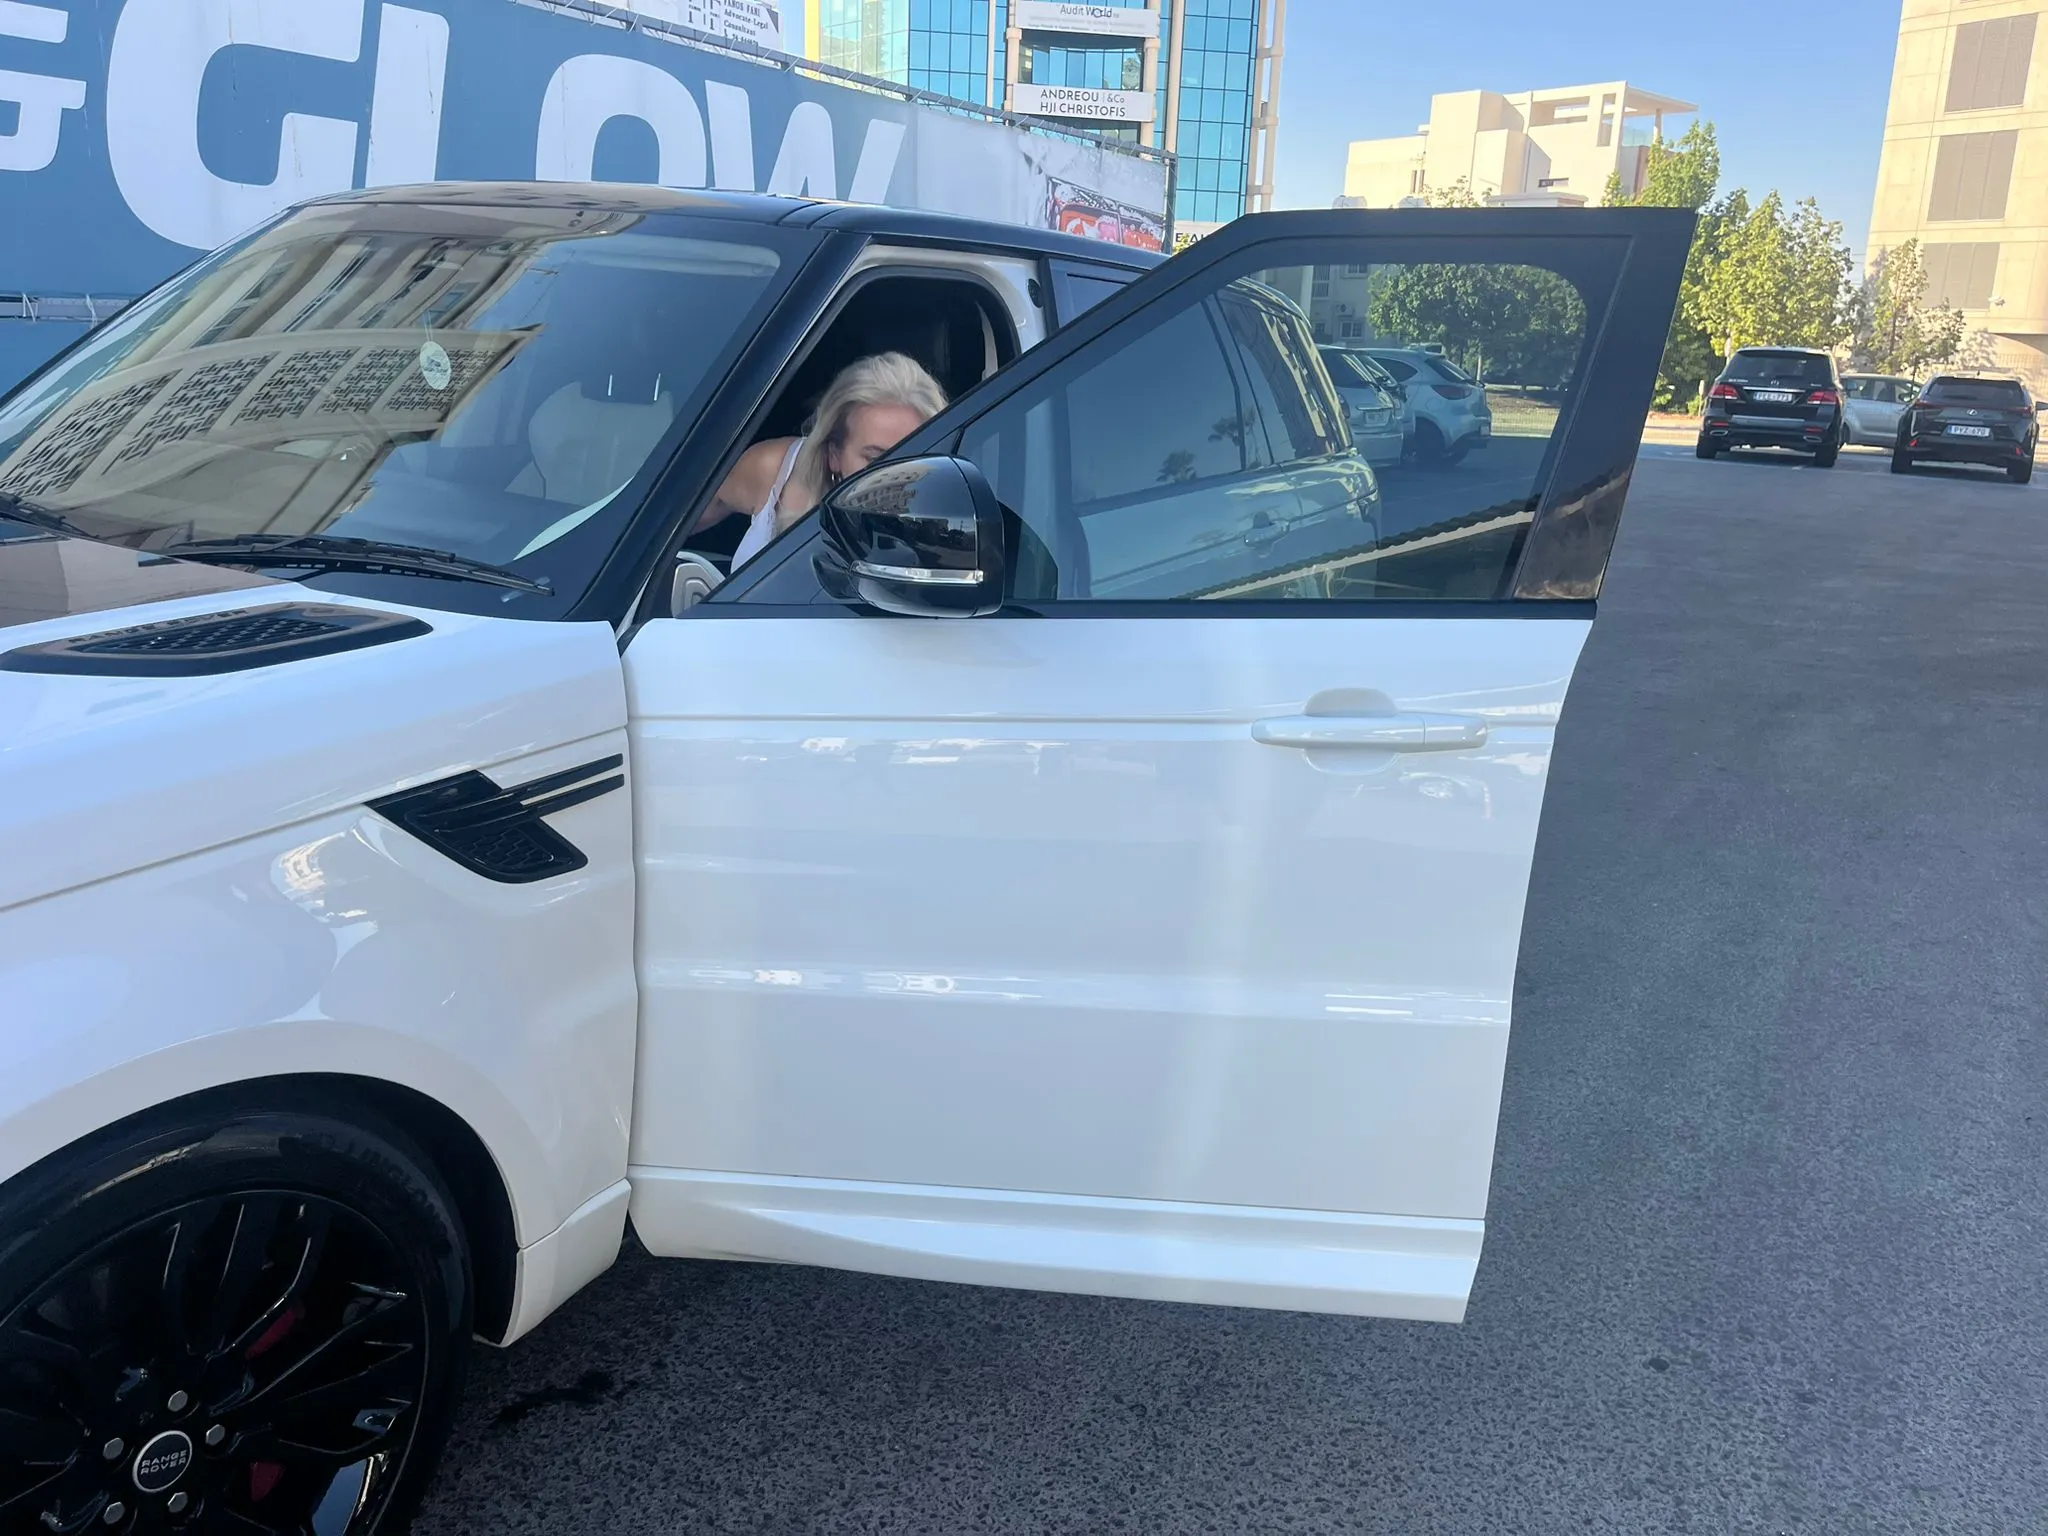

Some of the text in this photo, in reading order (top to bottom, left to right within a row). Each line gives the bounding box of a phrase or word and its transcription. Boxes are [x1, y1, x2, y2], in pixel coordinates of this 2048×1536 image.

[1060, 5, 1084, 16] Audit
[1041, 89, 1099, 102] ANDREOU
[1040, 102, 1126, 117] HJI CHRISTOFIS
[141, 1457, 186, 1475] ROVER
[142, 1450, 187, 1467] RANGE
